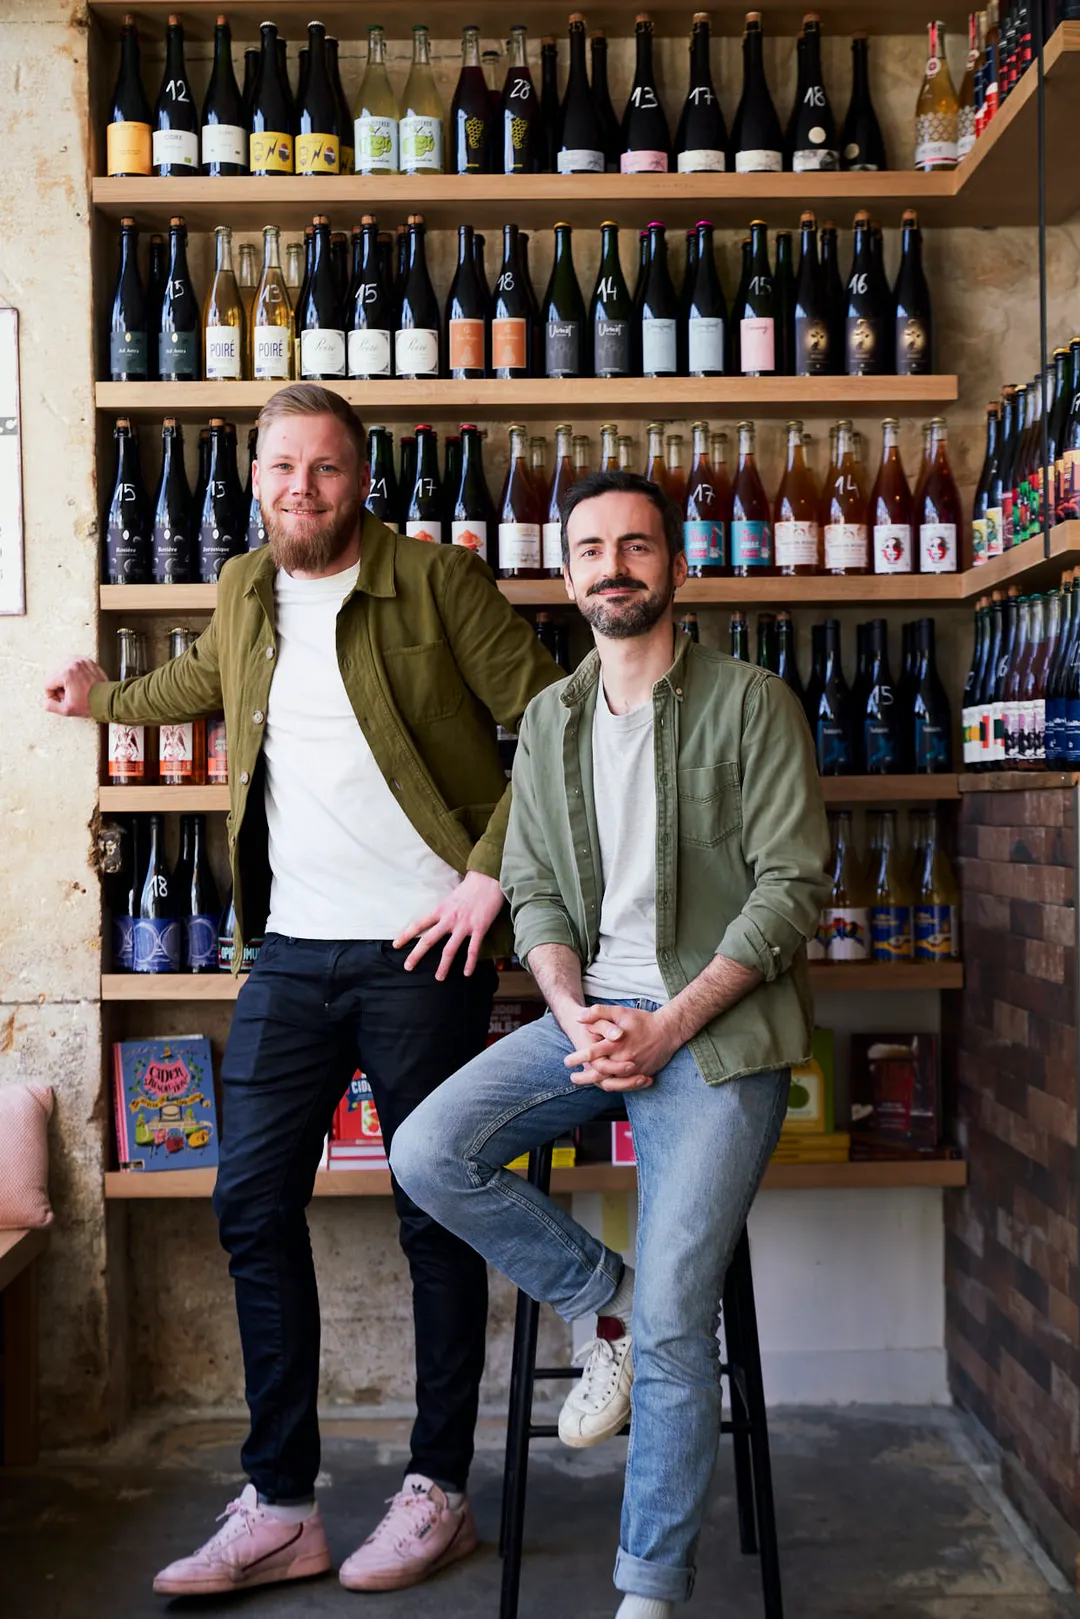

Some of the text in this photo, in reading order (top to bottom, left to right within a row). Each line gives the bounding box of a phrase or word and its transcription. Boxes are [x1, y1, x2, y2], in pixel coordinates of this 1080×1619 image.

[166, 79, 190, 102] 12
[631, 86, 658, 109] 13
[688, 87, 714, 105] 17
[803, 86, 826, 107] 18
[165, 279, 185, 300] 15
[497, 272, 516, 291] 18
[597, 277, 618, 303] 14
[849, 273, 869, 295] 16
[354, 283, 378, 303] 15
[210, 340, 235, 358] POIRÉ
[258, 340, 284, 358] POIRÉ
[114, 483, 137, 502] 15
[206, 480, 227, 499] 15
[413, 478, 437, 498] 17
[692, 484, 716, 505] 17
[871, 684, 894, 706] 15
[149, 874, 169, 898] 18
